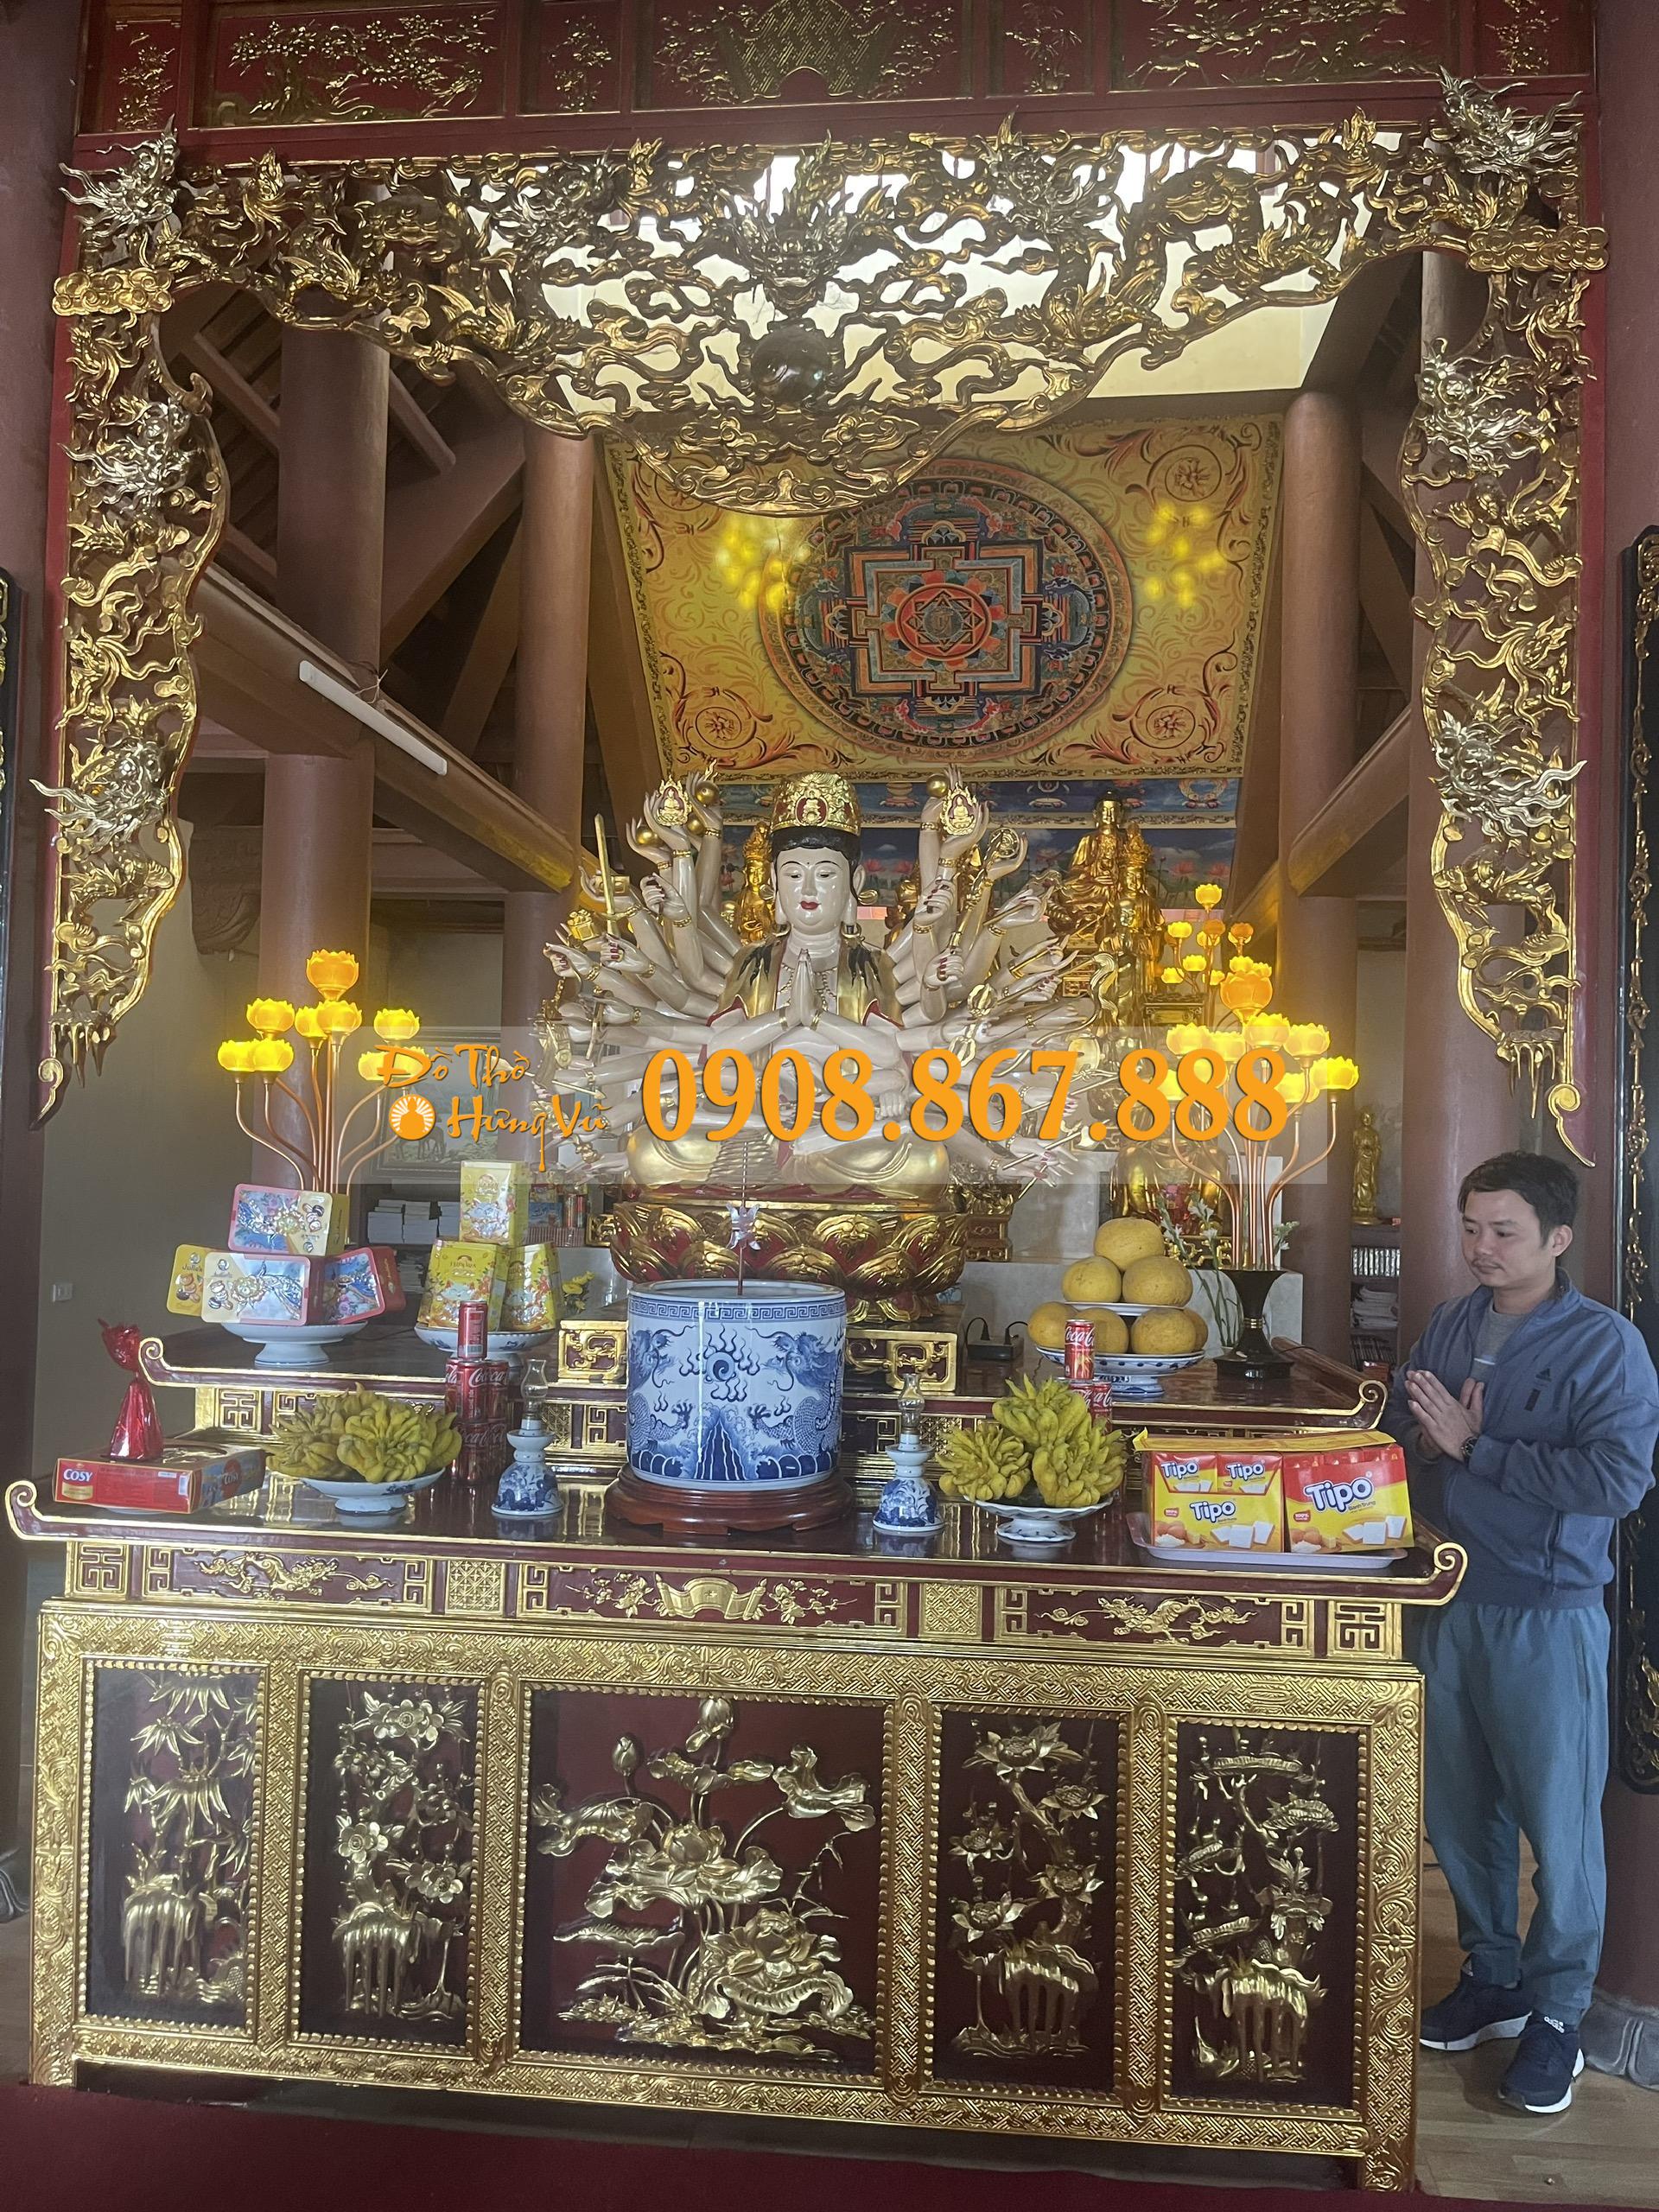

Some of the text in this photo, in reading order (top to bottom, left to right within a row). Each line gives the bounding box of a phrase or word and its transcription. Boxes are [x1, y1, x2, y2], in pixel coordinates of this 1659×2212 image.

[63, 1468, 93, 1483] COSY
[1161, 1460, 1199, 1480] Tipo
[1226, 1461, 1266, 1481] Tipo
[1304, 1477, 1375, 1513] Tipo
[1189, 1500, 1236, 1523] Tipo
